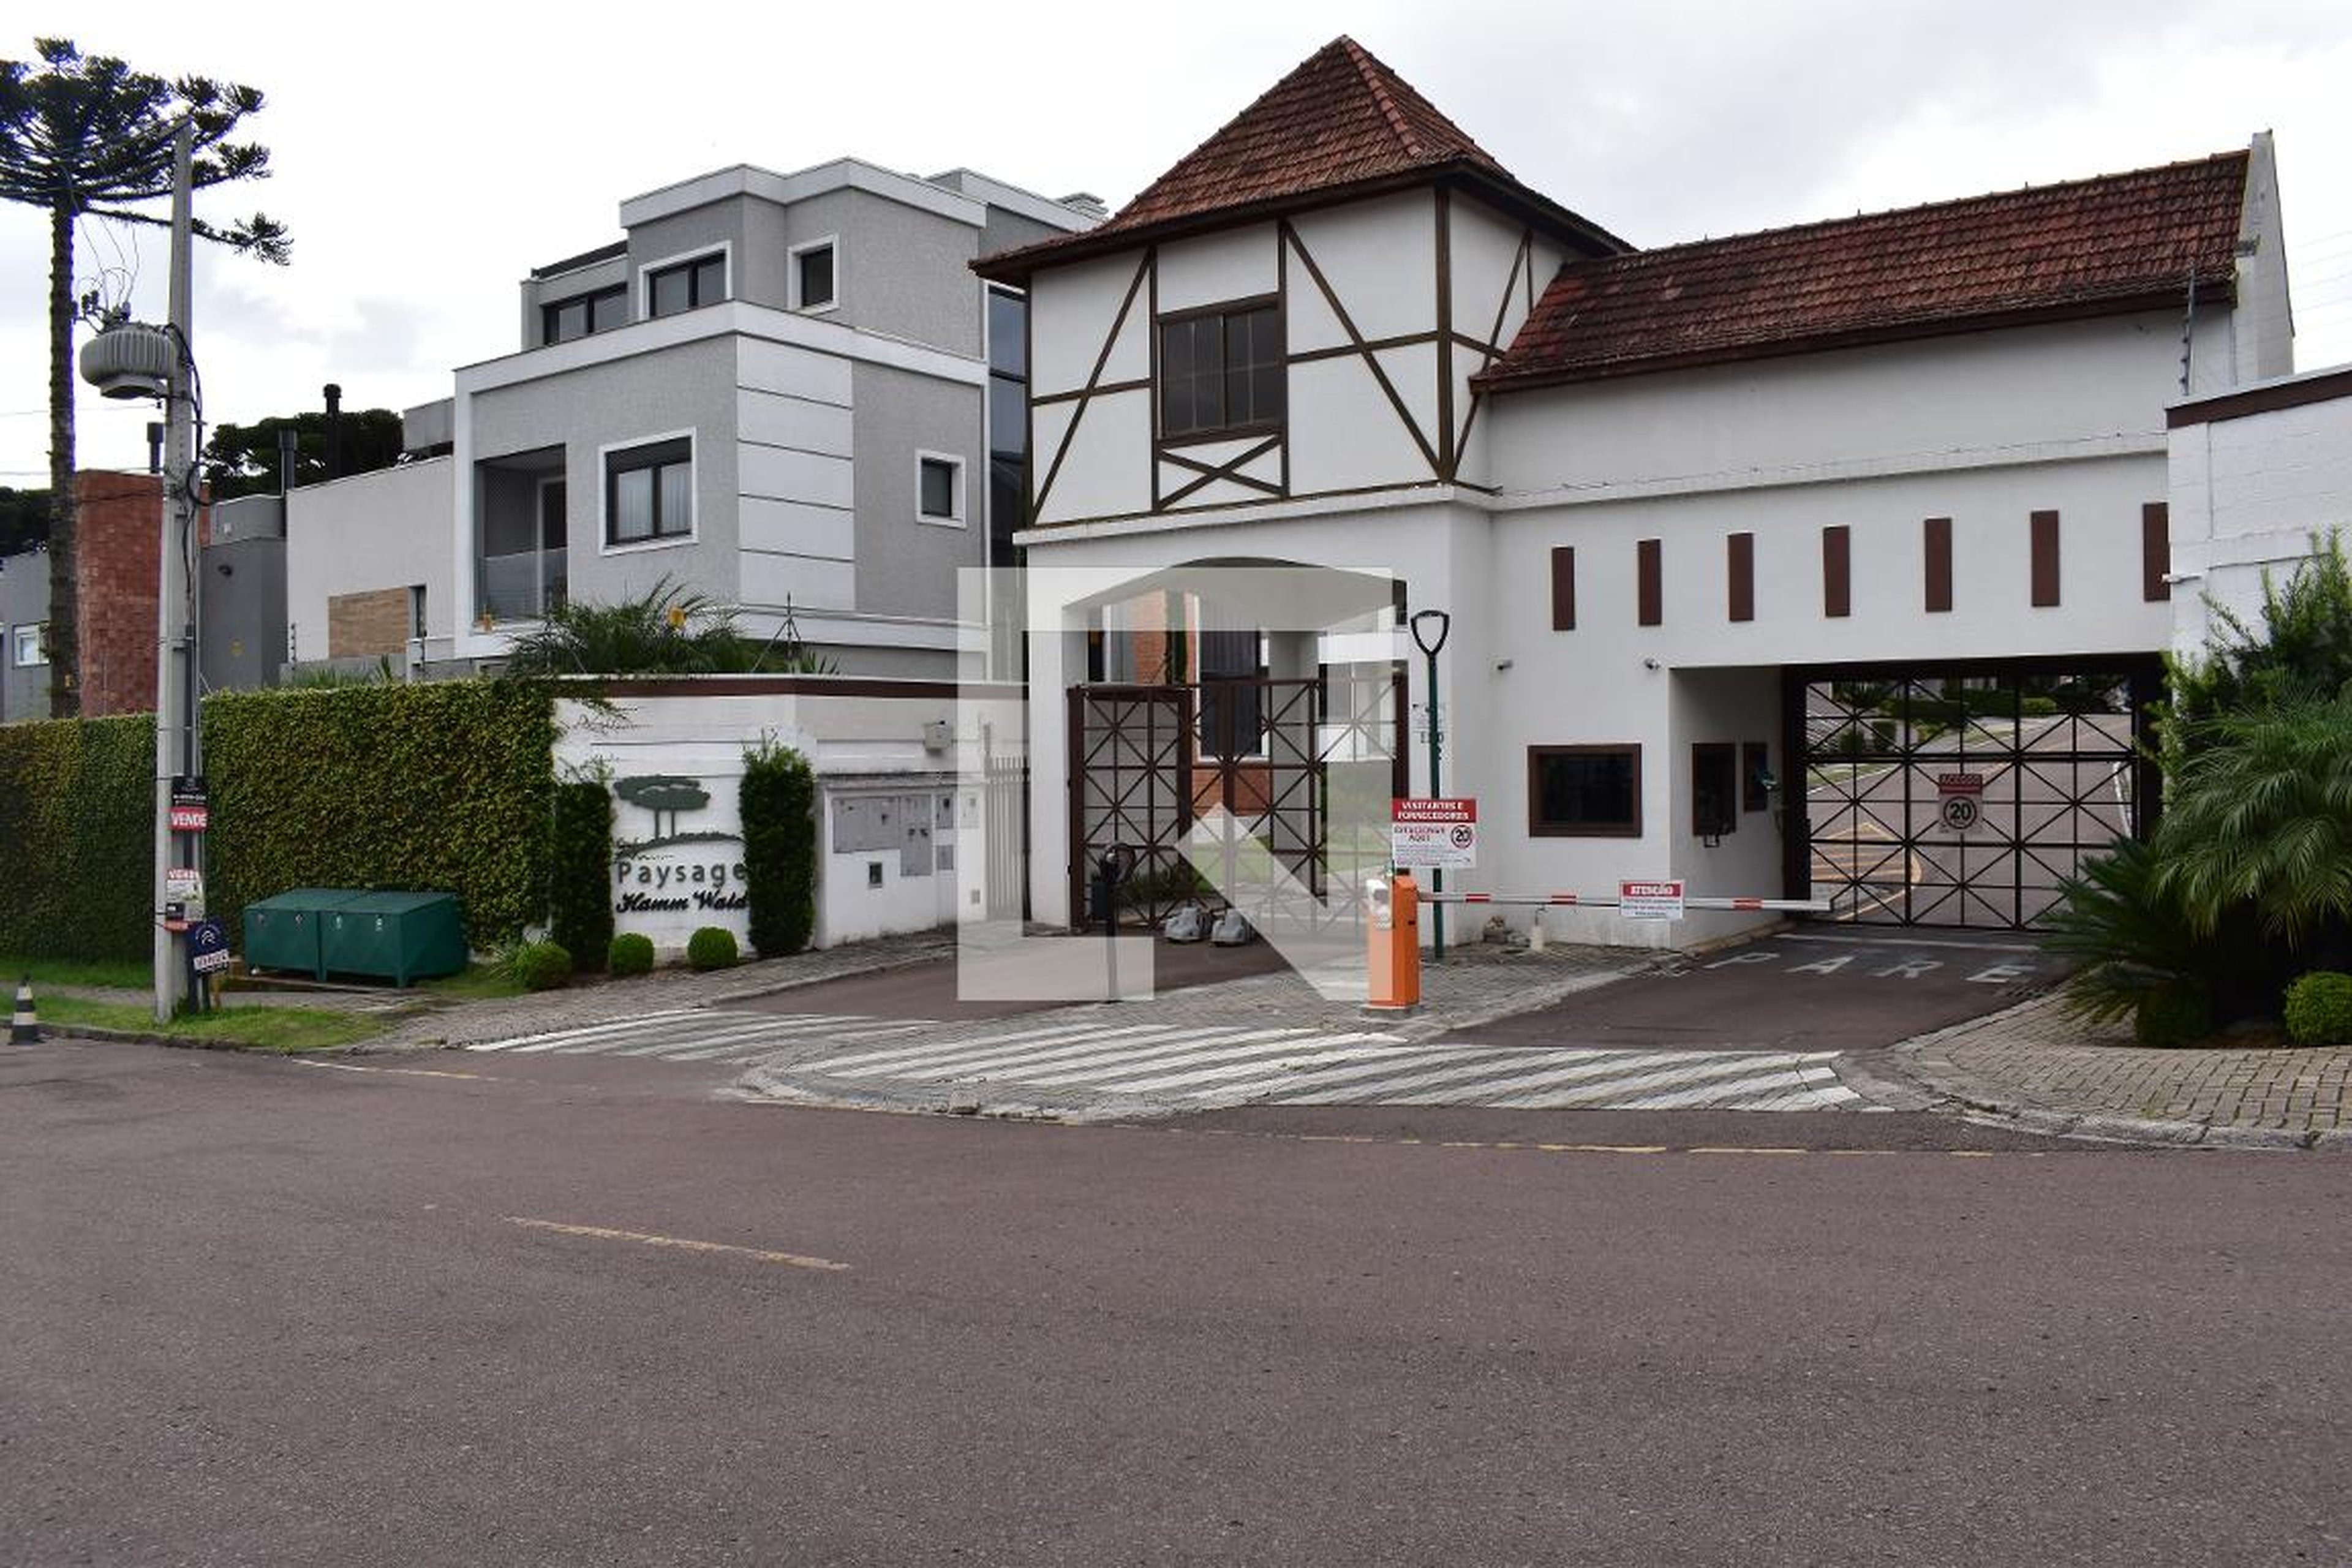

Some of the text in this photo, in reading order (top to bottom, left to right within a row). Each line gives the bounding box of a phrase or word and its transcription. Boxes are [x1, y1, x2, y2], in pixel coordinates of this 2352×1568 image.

[171, 812, 208, 827] VENDE
[1950, 802, 1972, 821] 20
[1455, 829, 1471, 842] 20
[617, 862, 747, 889] Paysage
[1703, 952, 2036, 983] PARE
